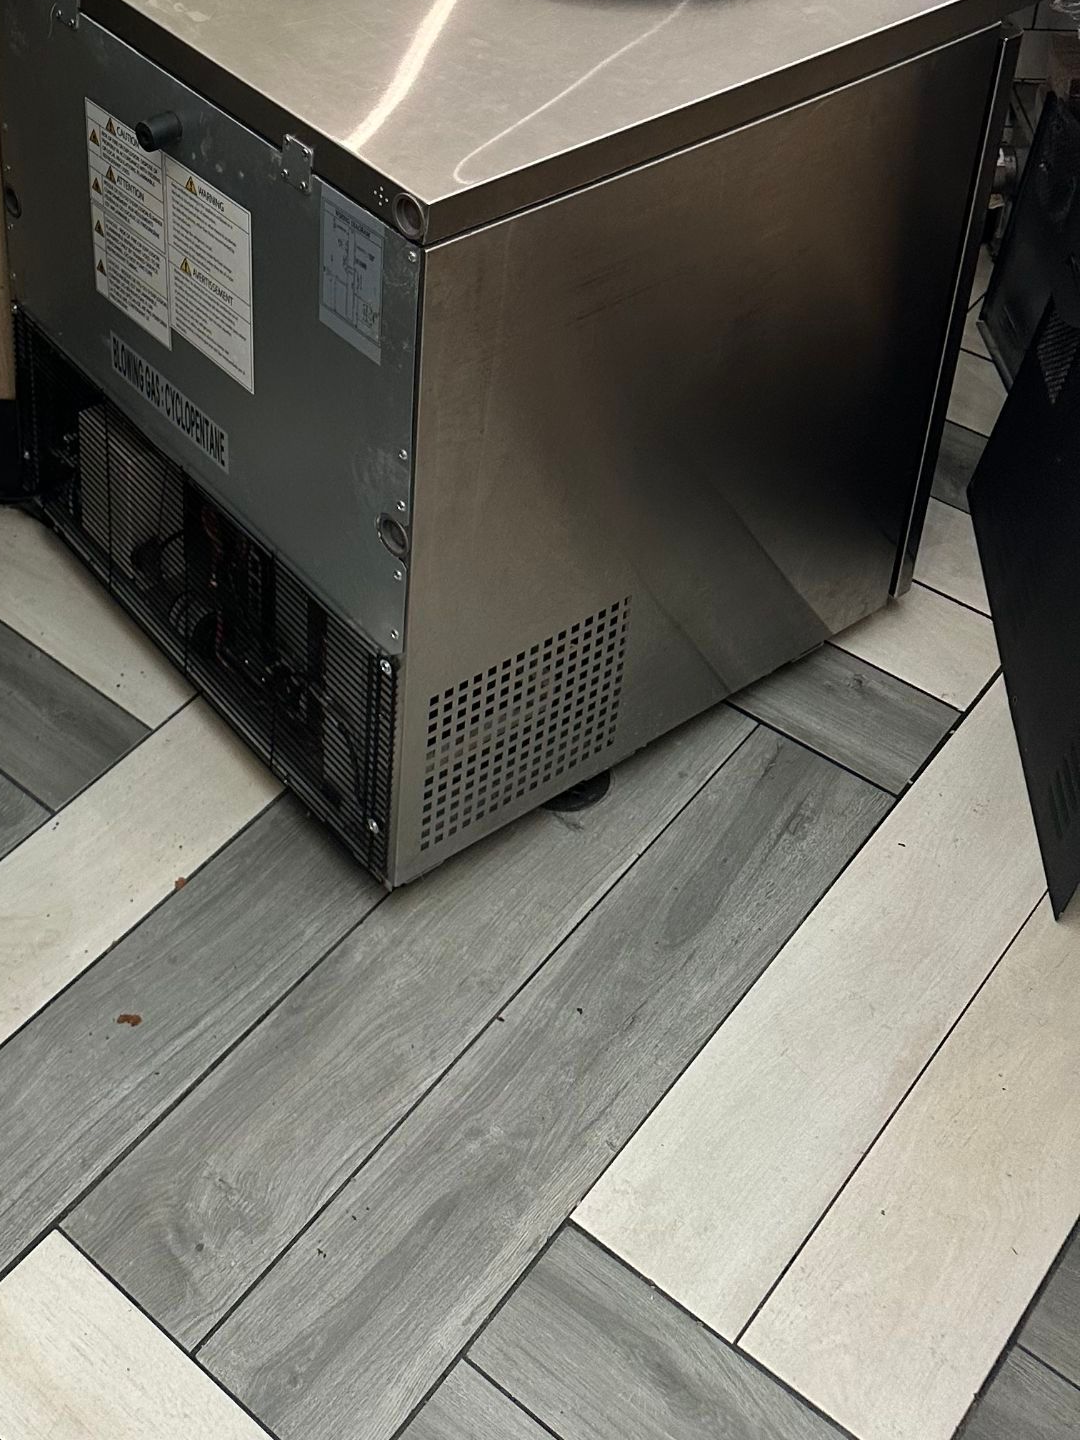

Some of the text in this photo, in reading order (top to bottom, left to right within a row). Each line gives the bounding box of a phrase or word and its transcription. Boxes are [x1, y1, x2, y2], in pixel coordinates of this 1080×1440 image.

[116, 175, 145, 202] ATTENTION
[197, 185, 225, 213] WARNING
[191, 267, 234, 307] AVERTISSEMENT
[112, 335, 145, 393] BLOWING
[144, 365, 161, 408] GAS
[164, 383, 226, 467] CYCLOPENTANE
